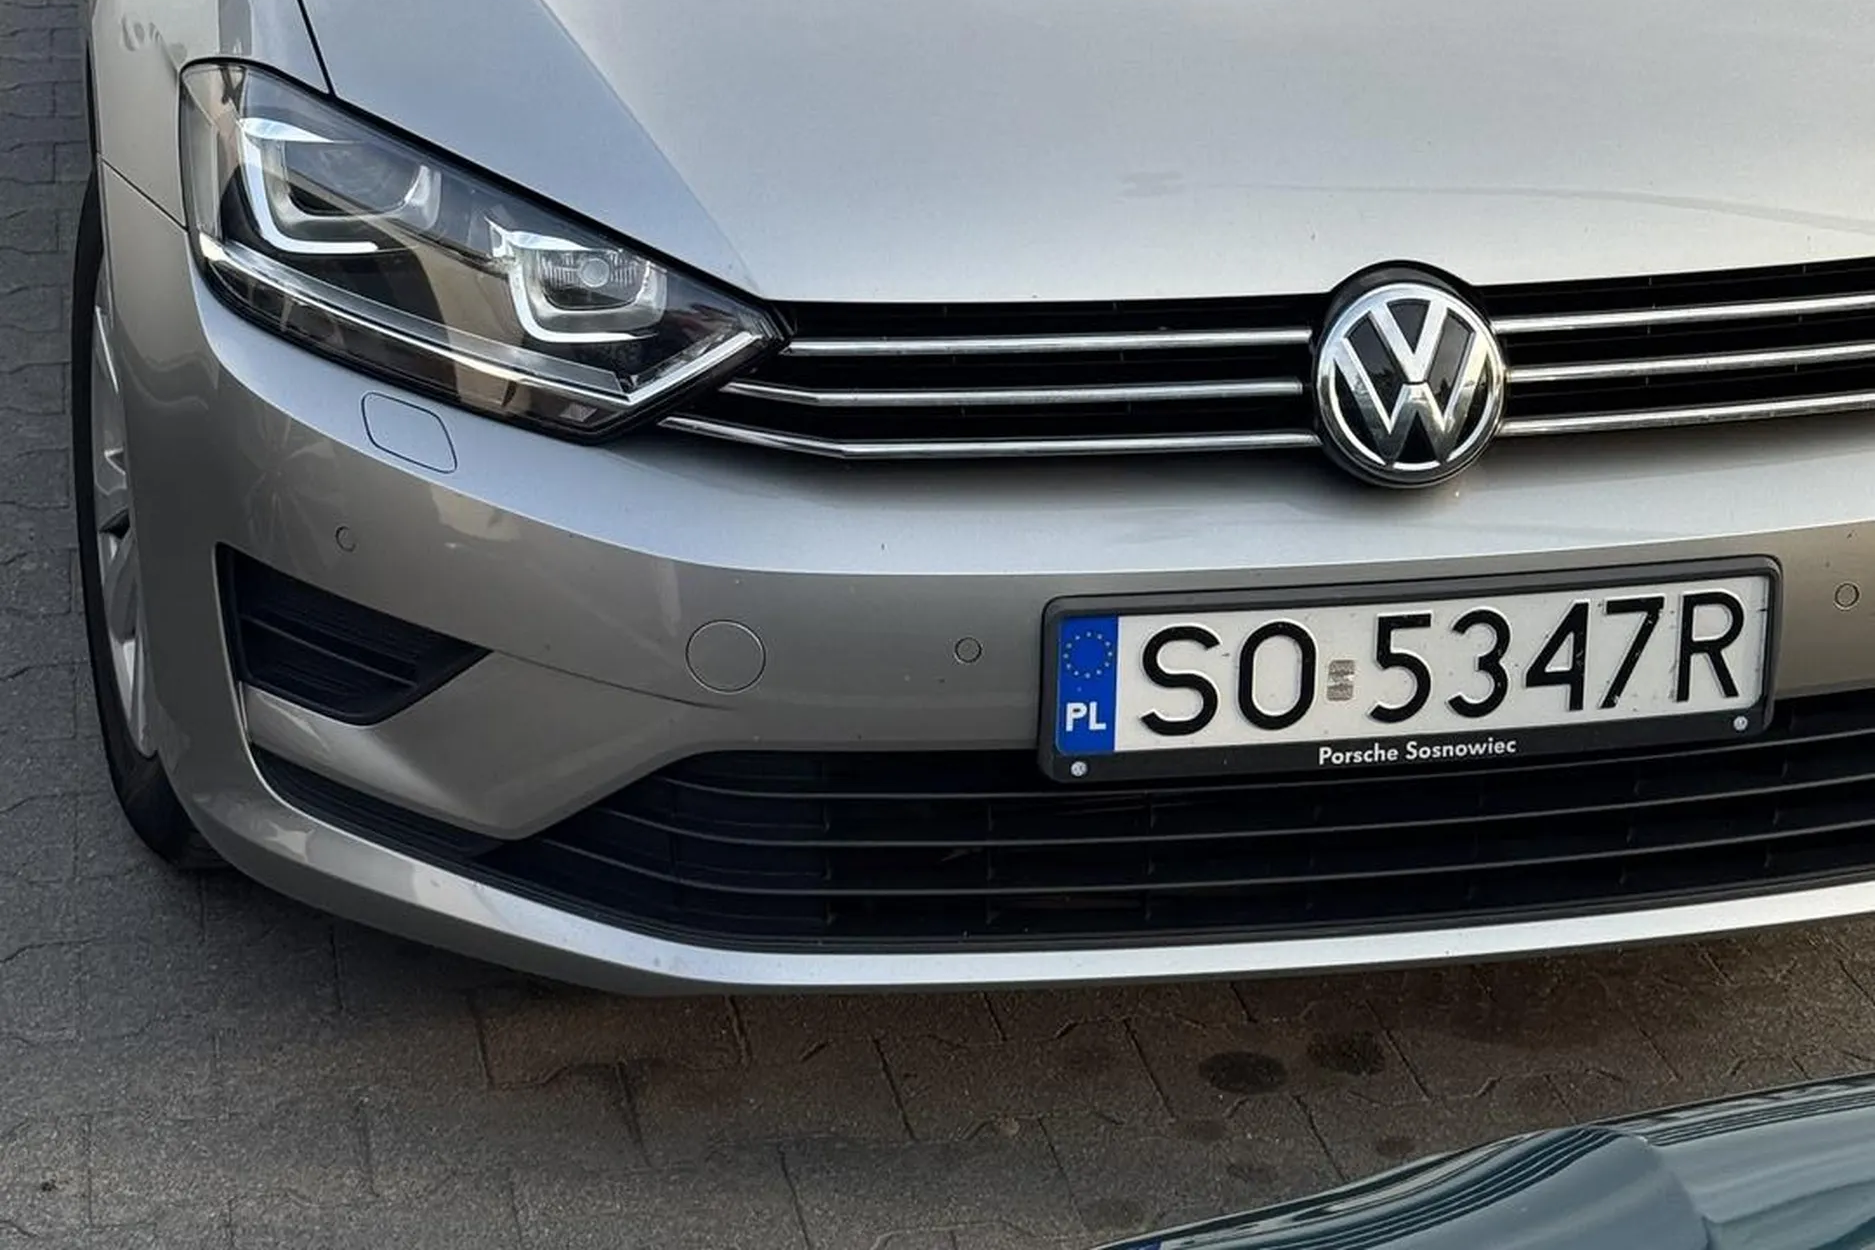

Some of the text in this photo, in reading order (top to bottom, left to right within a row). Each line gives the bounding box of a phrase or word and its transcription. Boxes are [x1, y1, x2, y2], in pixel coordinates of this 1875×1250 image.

[1139, 590, 1745, 736] SO 5347R
[1065, 703, 1107, 733] PL
[1319, 737, 1517, 766] Porsche Sosnowiec
